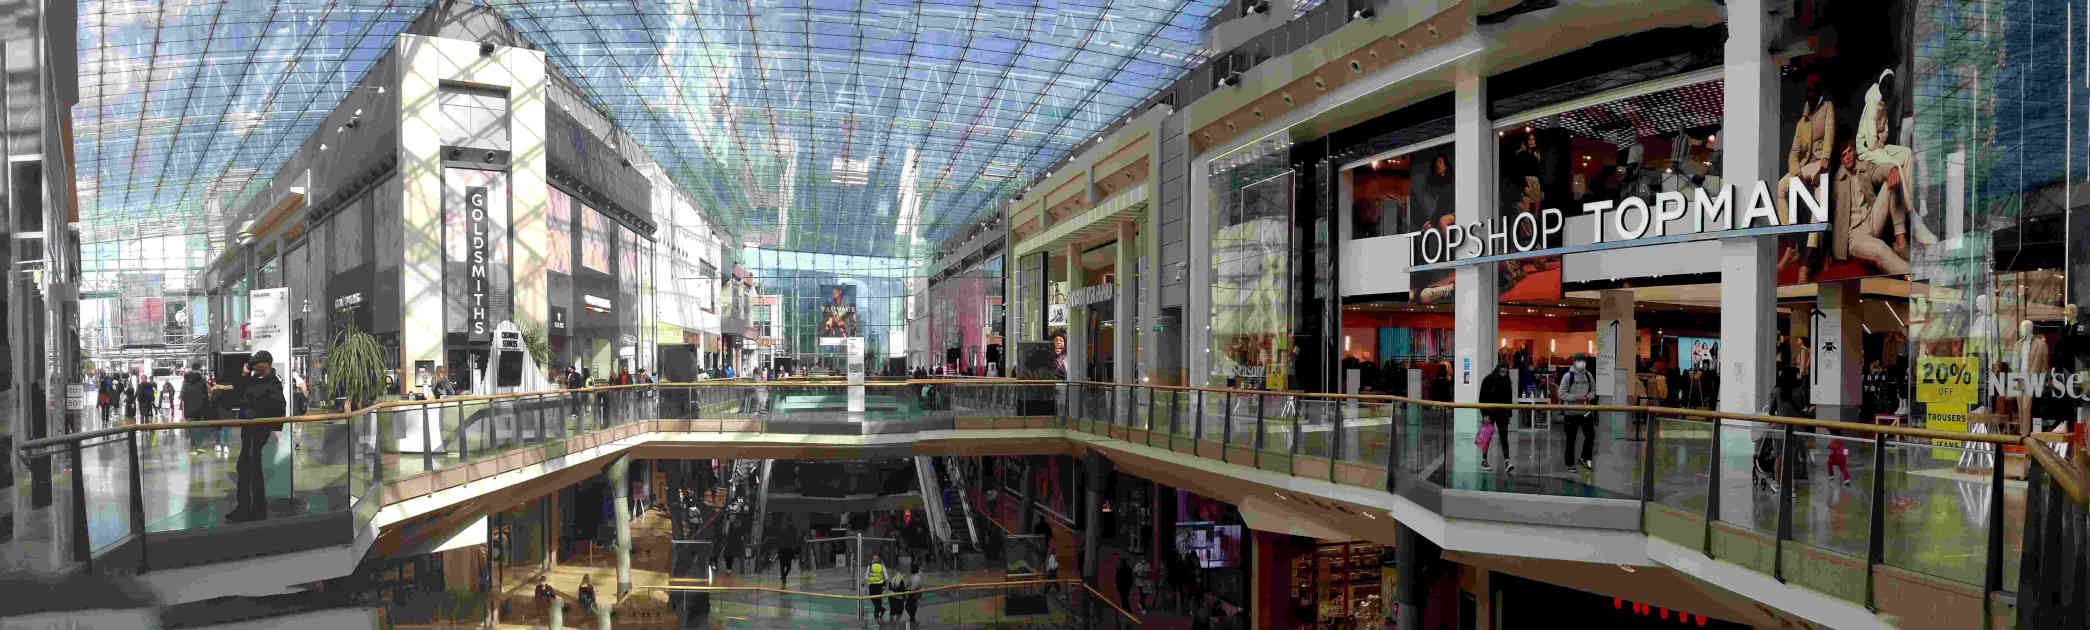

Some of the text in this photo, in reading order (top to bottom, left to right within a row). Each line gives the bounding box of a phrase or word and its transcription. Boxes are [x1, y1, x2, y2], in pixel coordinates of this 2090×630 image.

[1409, 174, 1829, 266] TOPSHOP TOPMAN
[471, 193, 486, 334] GOLDSMITHS
[1922, 362, 1971, 384] 20%
[1988, 372, 2046, 398] NEW
[1938, 387, 1953, 397] OFF
[1928, 413, 1967, 423] TROUSERS
